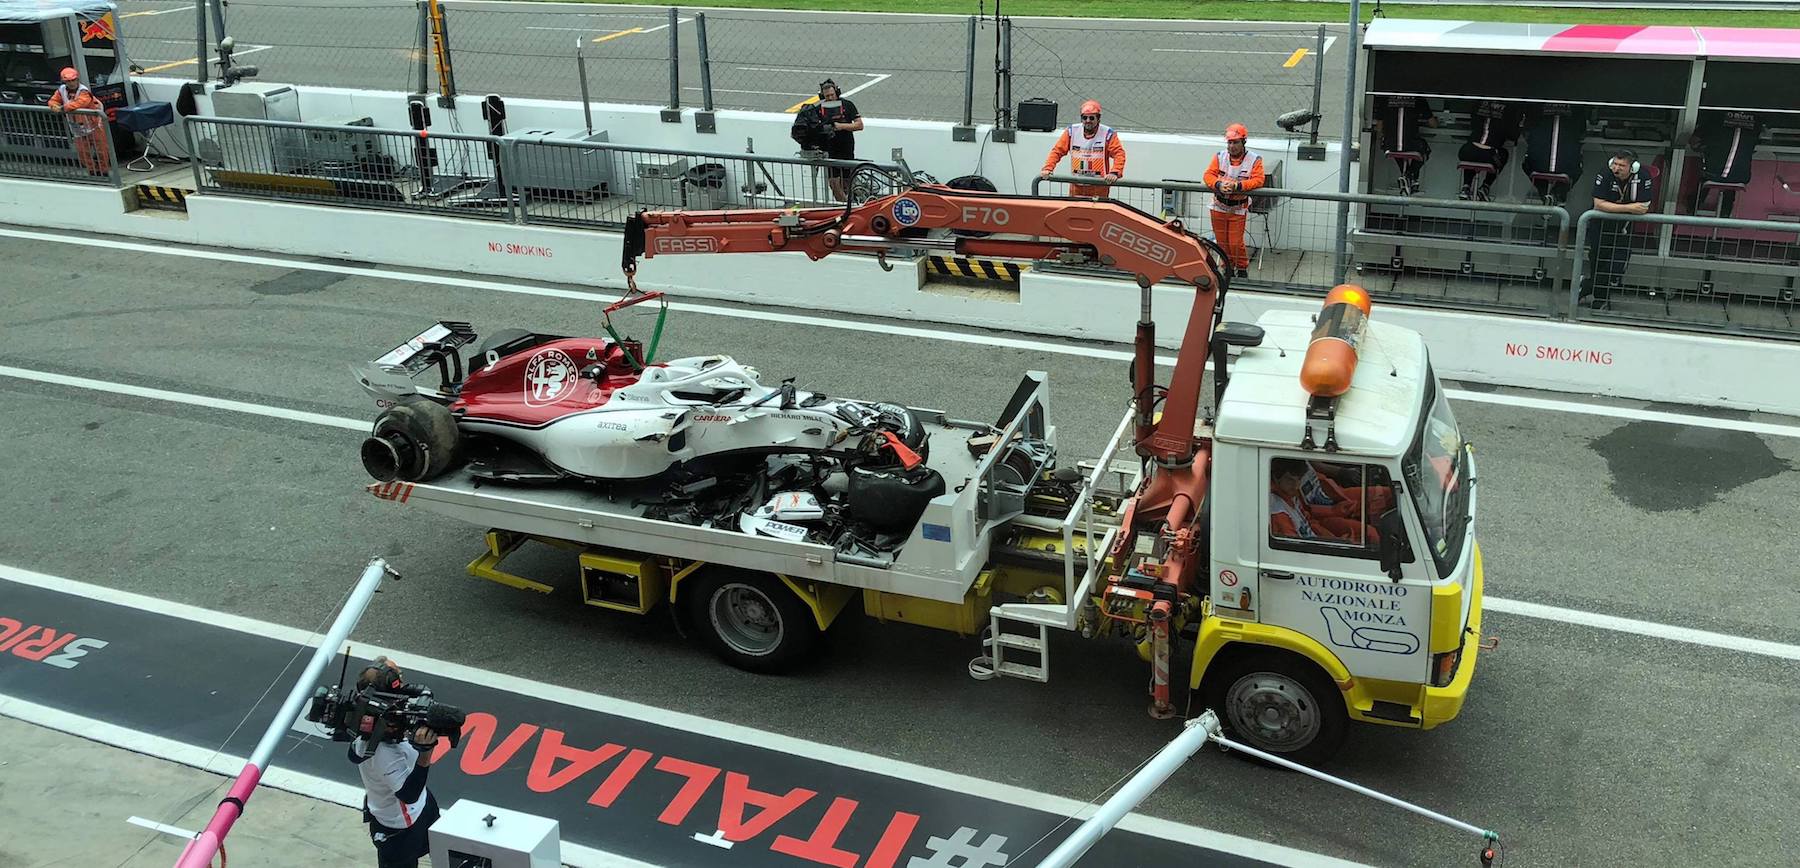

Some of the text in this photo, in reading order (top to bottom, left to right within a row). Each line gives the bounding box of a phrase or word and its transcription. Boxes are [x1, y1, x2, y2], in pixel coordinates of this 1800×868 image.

[962, 206, 1010, 226] F70
[488, 241, 553, 258] NO SMOKING
[658, 239, 714, 252] FASSI
[1105, 225, 1172, 263] FASSI
[483, 349, 500, 372] 9
[1505, 343, 1613, 365] NO SMOKING
[527, 350, 576, 383] ALFA ROMEO
[376, 399, 397, 408] Cla
[764, 521, 806, 536] POWER
[1296, 575, 1408, 598] AUTODROMO
[1301, 590, 1401, 612] NAZIONALE
[1344, 610, 1406, 627] MONZA
